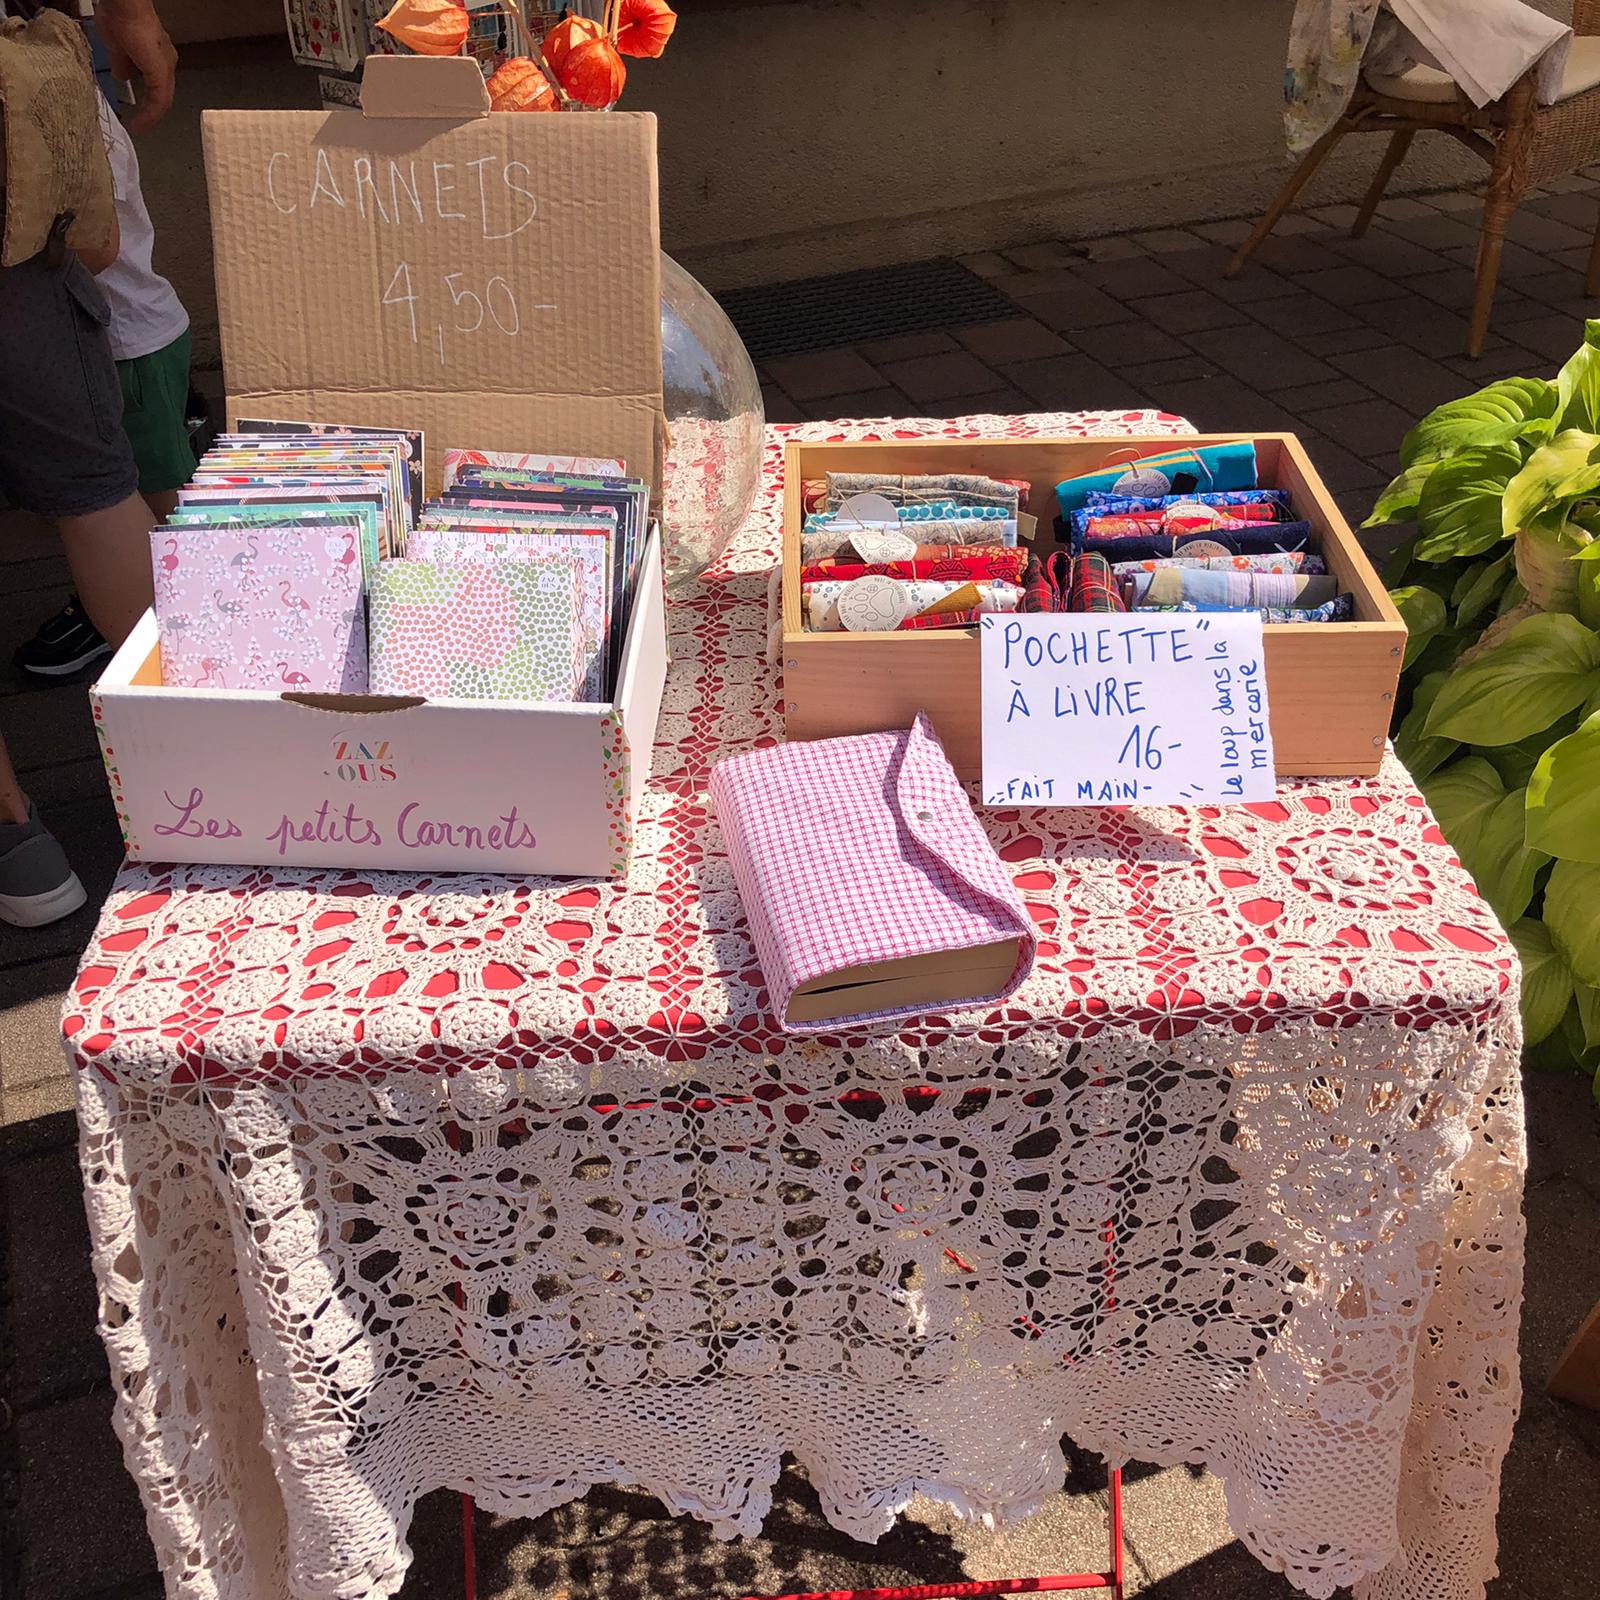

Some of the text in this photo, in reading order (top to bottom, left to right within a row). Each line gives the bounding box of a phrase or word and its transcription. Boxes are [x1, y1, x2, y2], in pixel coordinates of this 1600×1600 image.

[267, 148, 537, 241] CARNETS
[1204, 640, 1230, 661] la
[1006, 679, 1031, 723] À
[1211, 667, 1235, 716] dans
[1236, 658, 1268, 770] mercerie
[332, 740, 394, 760] ZAZ
[1219, 725, 1248, 768] loup
[337, 763, 397, 782] OUS
[154, 787, 538, 856] Les petits Carnets
